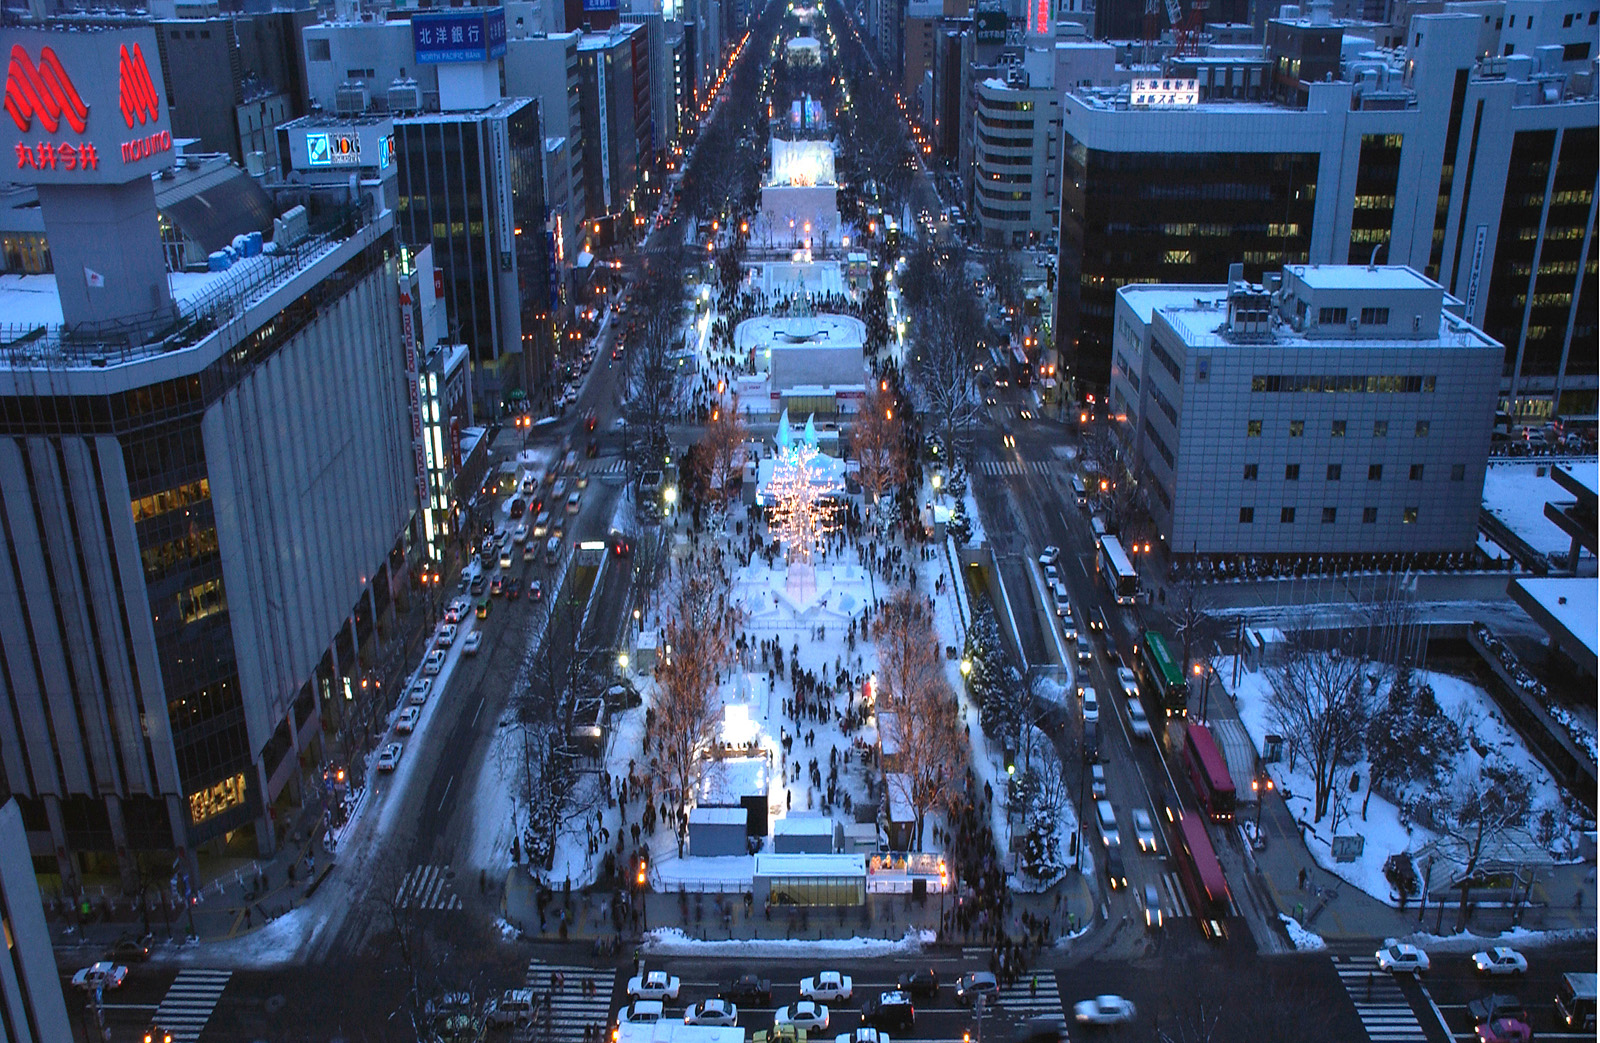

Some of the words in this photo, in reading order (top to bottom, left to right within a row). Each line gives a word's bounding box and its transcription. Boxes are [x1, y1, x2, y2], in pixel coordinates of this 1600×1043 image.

[420, 26, 479, 44] 北洋銀行
[1136, 80, 1195, 90] 北海道新聞
[331, 137, 360, 155] JOG
[15, 140, 99, 171] 丸井今井
